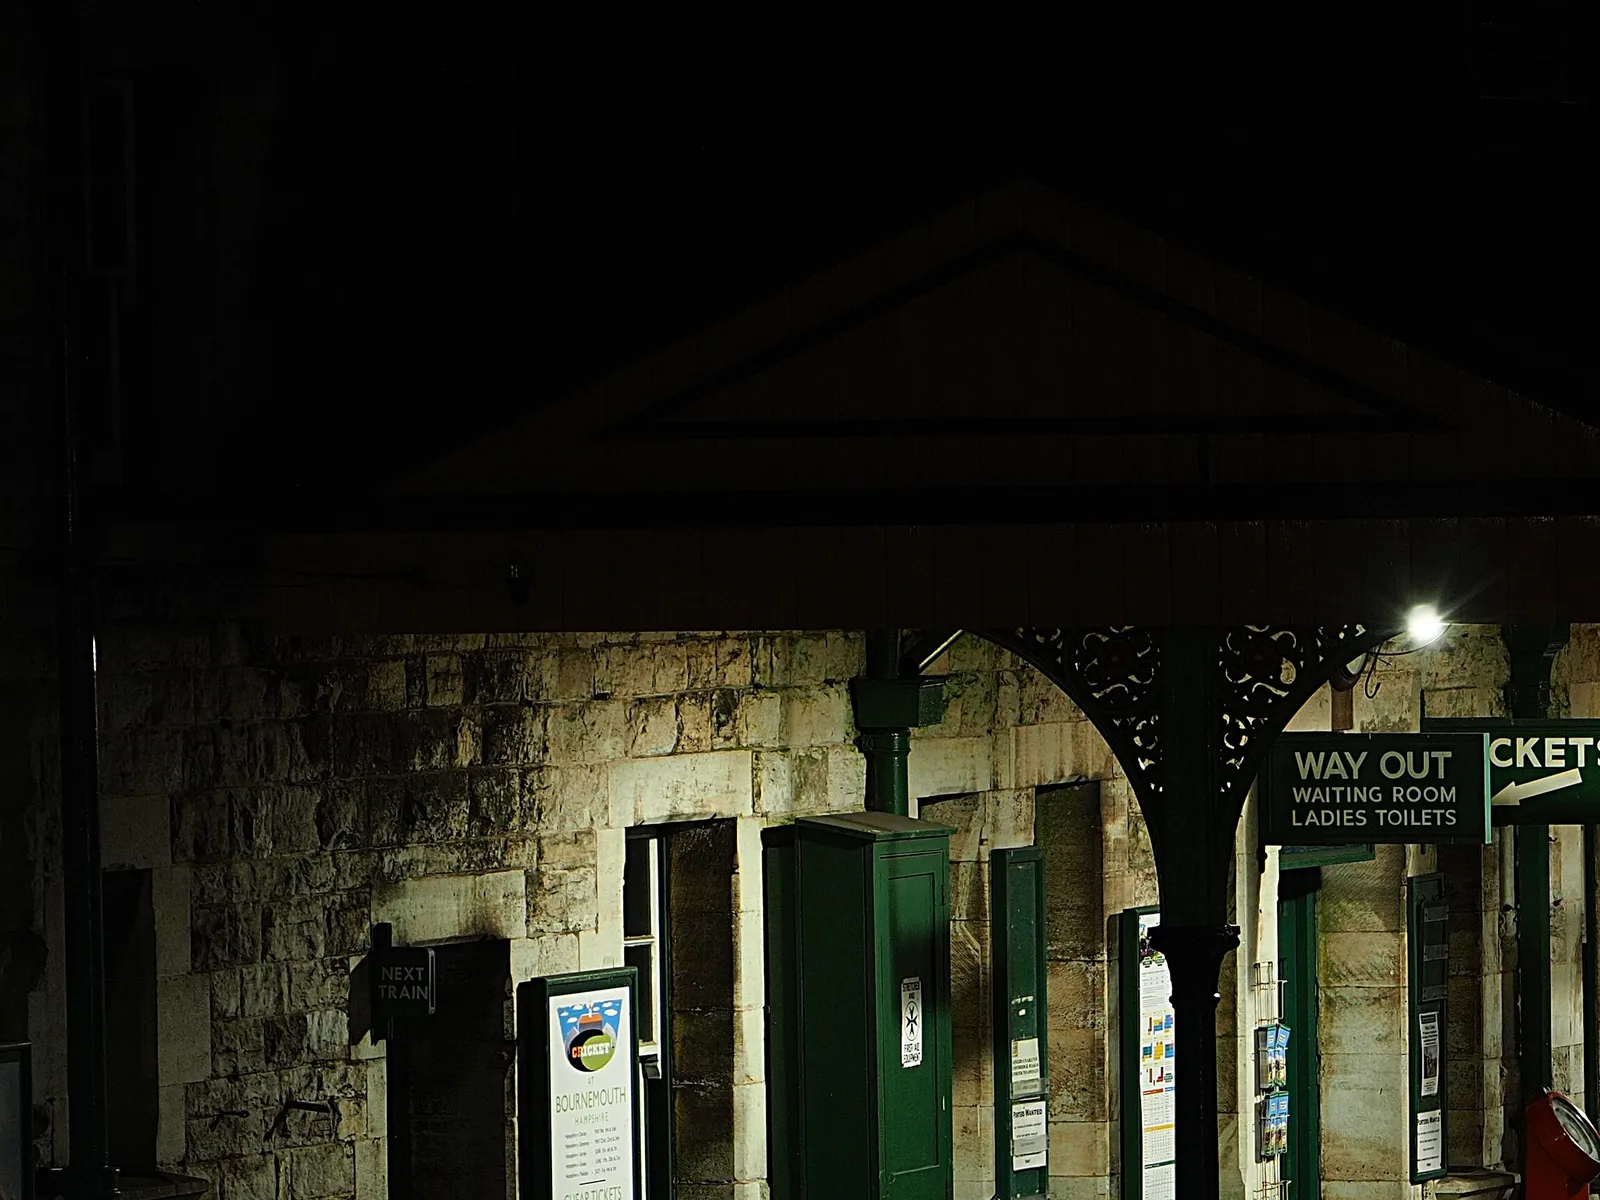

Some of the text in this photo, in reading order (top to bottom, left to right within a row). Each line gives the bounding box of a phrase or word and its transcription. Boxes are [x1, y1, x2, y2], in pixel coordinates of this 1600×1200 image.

[1295, 751, 1453, 780] WAY OUT
[1293, 786, 1457, 804] WAITING ROOM
[1292, 809, 1458, 827] LADIES TOILETS
[381, 966, 425, 982] NEXT
[378, 984, 429, 1000] TRAIN
[572, 1043, 610, 1058] CRICKET
[588, 1076, 595, 1086] AT
[556, 1086, 627, 1113] BOURNEMOUTH
[574, 1112, 609, 1126] HAMPSHIRE
